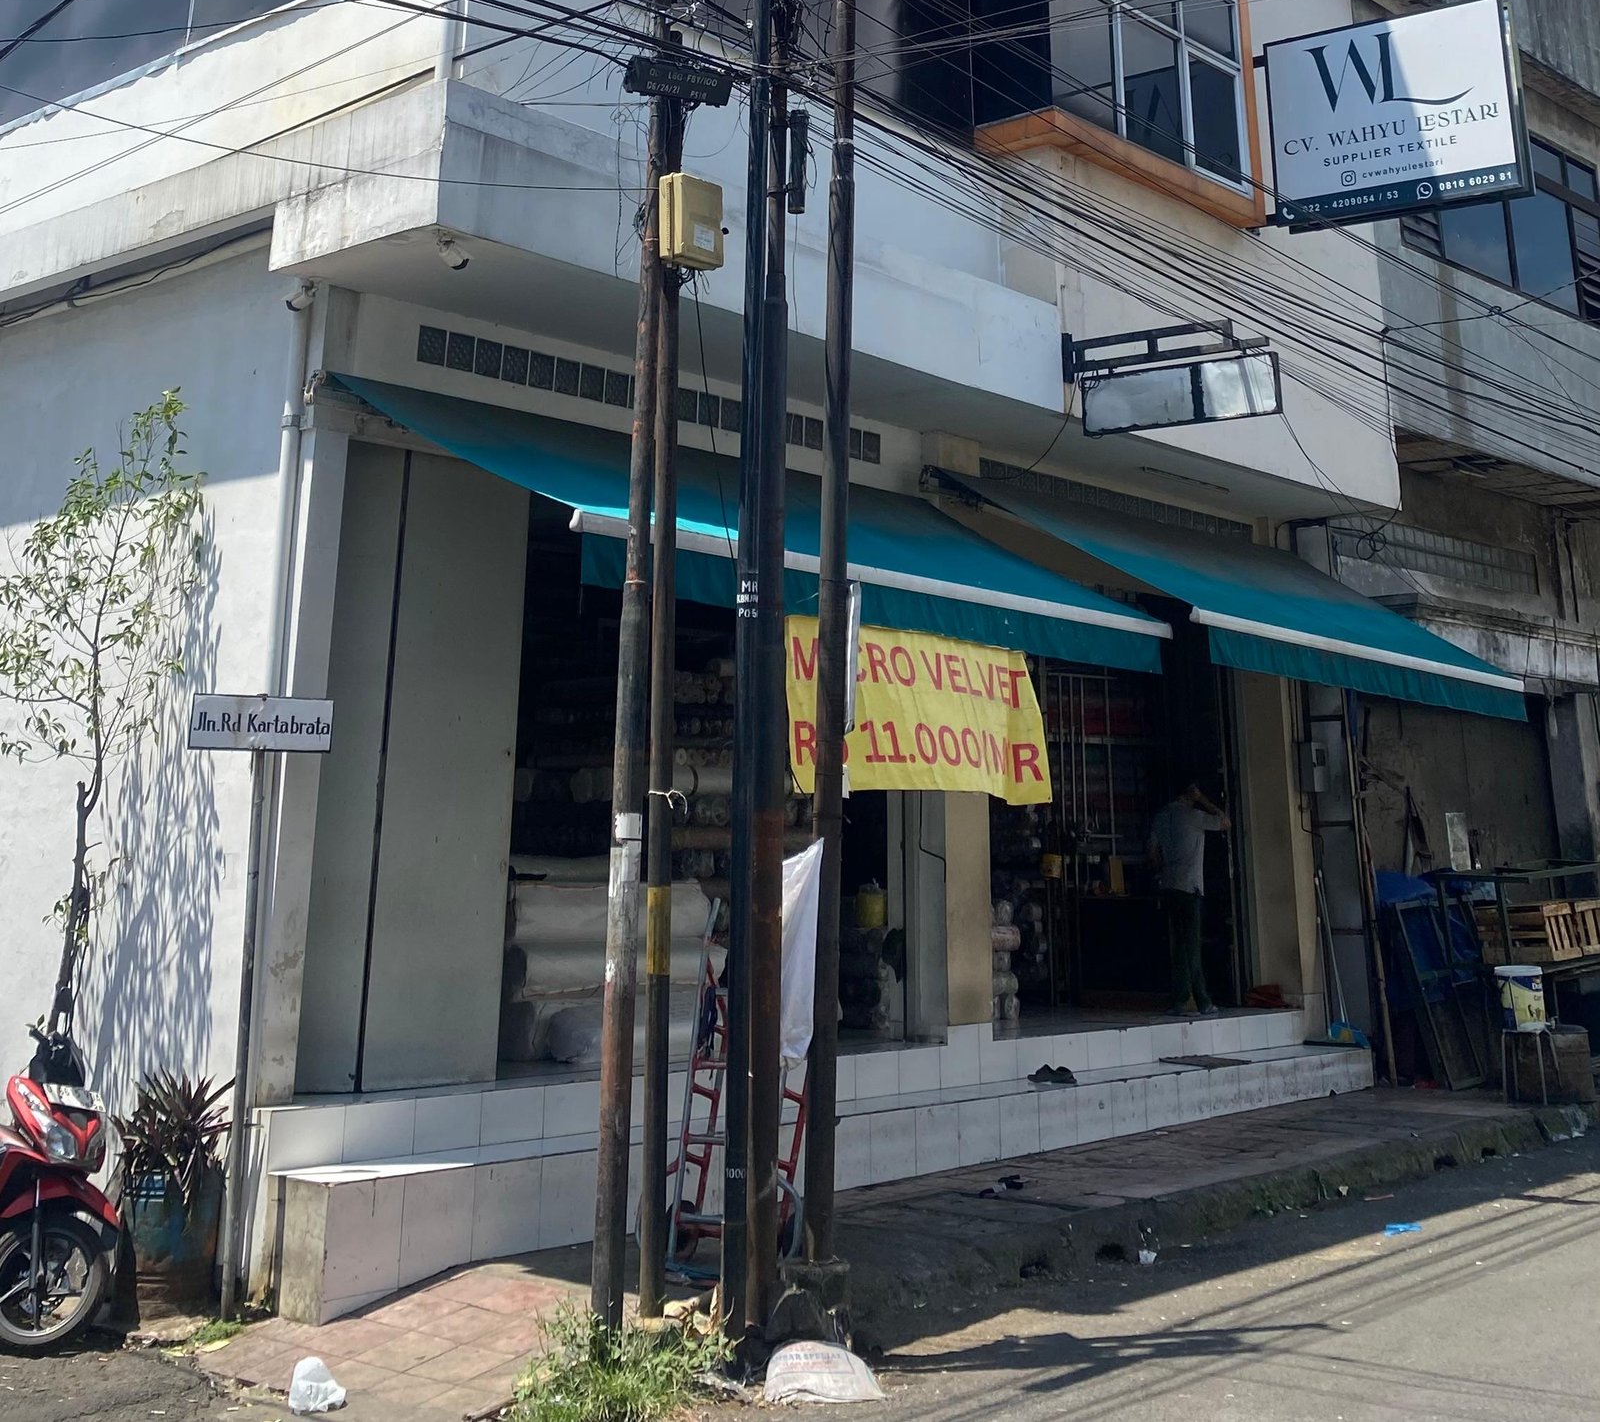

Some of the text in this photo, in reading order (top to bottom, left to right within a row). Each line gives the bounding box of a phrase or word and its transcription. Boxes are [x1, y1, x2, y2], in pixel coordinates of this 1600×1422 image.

[1283, 102, 1500, 157] CV. WAHYU LESTARI
[1323, 134, 1458, 168] SUPPLIER TEXTILE
[1361, 158, 1444, 180] cvwahyulestari
[1332, 194, 1375, 209] 4209054
[1386, 190, 1399, 200] 53
[1439, 178, 1466, 192] 0816
[1469, 174, 1495, 187] 6029
[1499, 171, 1512, 181] 81
[792, 636, 1026, 709] MRO VELVET
[246, 713, 331, 736] Kartabrata
[794, 720, 849, 767] R
